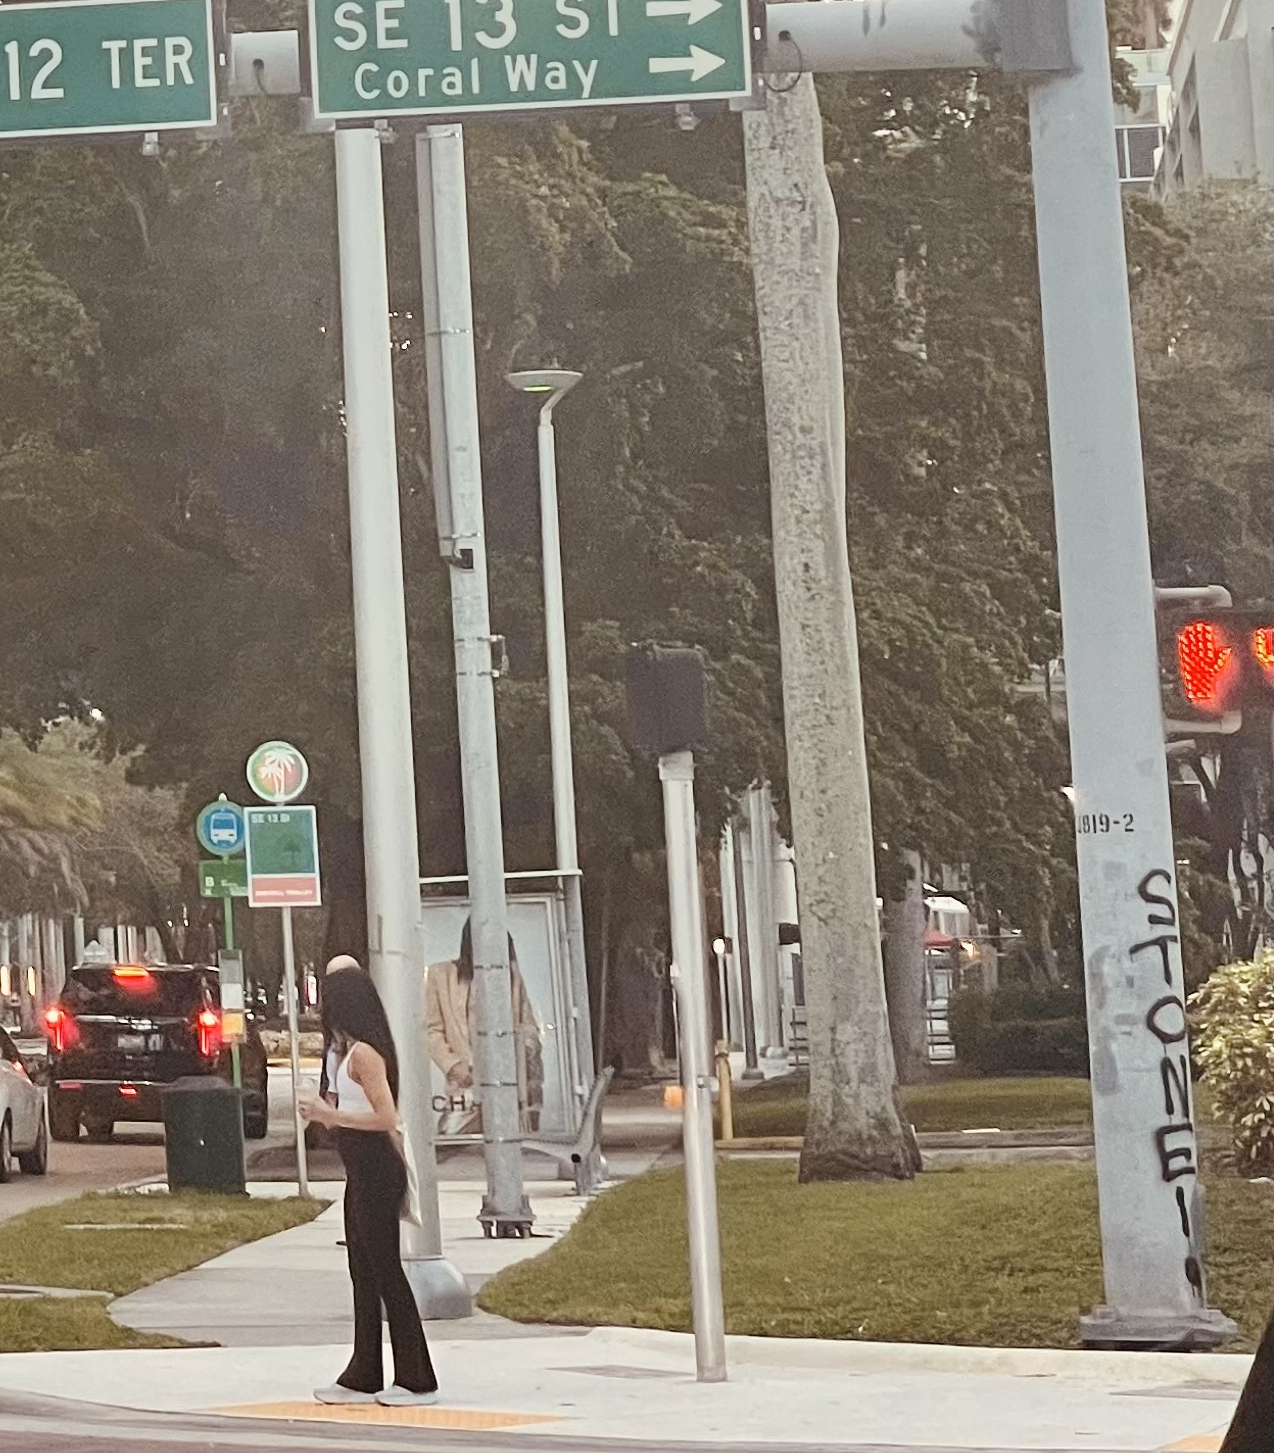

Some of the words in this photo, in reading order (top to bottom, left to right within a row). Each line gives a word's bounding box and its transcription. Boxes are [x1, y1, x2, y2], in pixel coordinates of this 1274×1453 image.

[4, 38, 65, 101] 12
[101, 35, 194, 90] TER
[353, 57, 481, 100] Coral
[504, 53, 600, 99] Way
